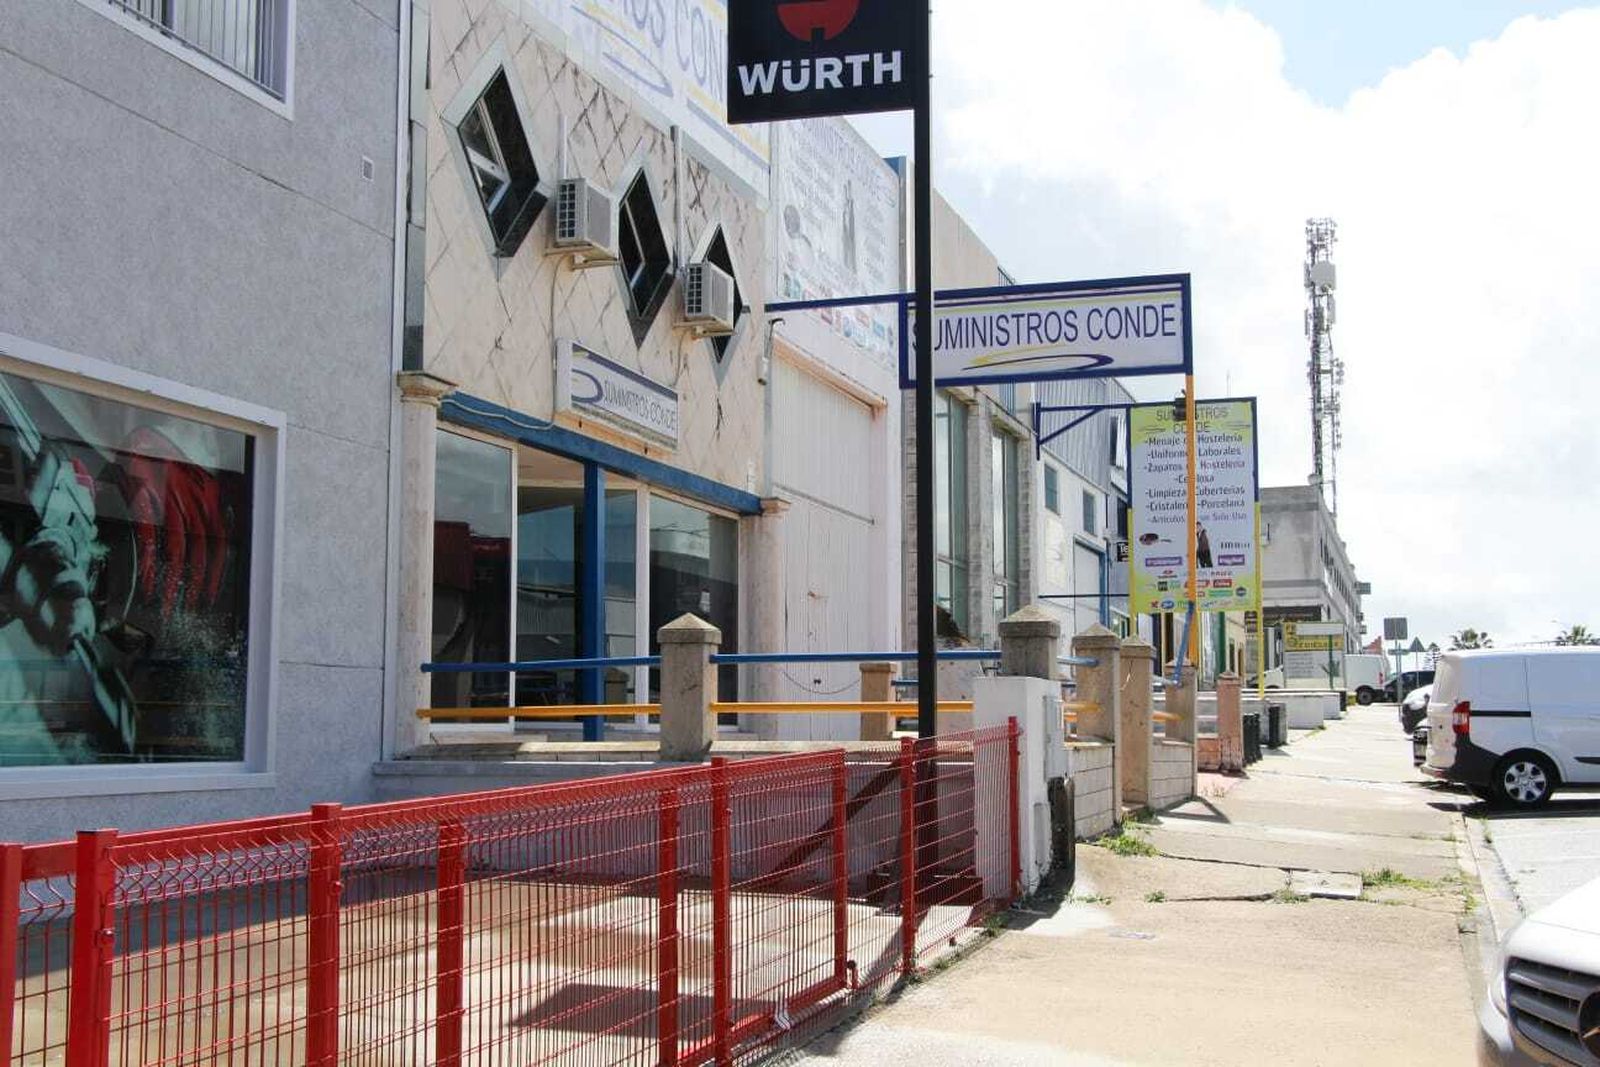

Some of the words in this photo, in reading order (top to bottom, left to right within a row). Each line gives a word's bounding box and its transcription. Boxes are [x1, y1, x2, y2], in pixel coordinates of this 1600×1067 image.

[738, 50, 902, 97] WÜRTH
[1086, 303, 1177, 342] CONDE
[1156, 405, 1229, 421] SUTROS
[1173, 420, 1211, 434] CODE
[1148, 448, 1189, 460] -Uniform
[1198, 444, 1242, 457] Laborales
[1174, 473, 1214, 484] -Celosa
[1145, 501, 1188, 511] -Cristaler
